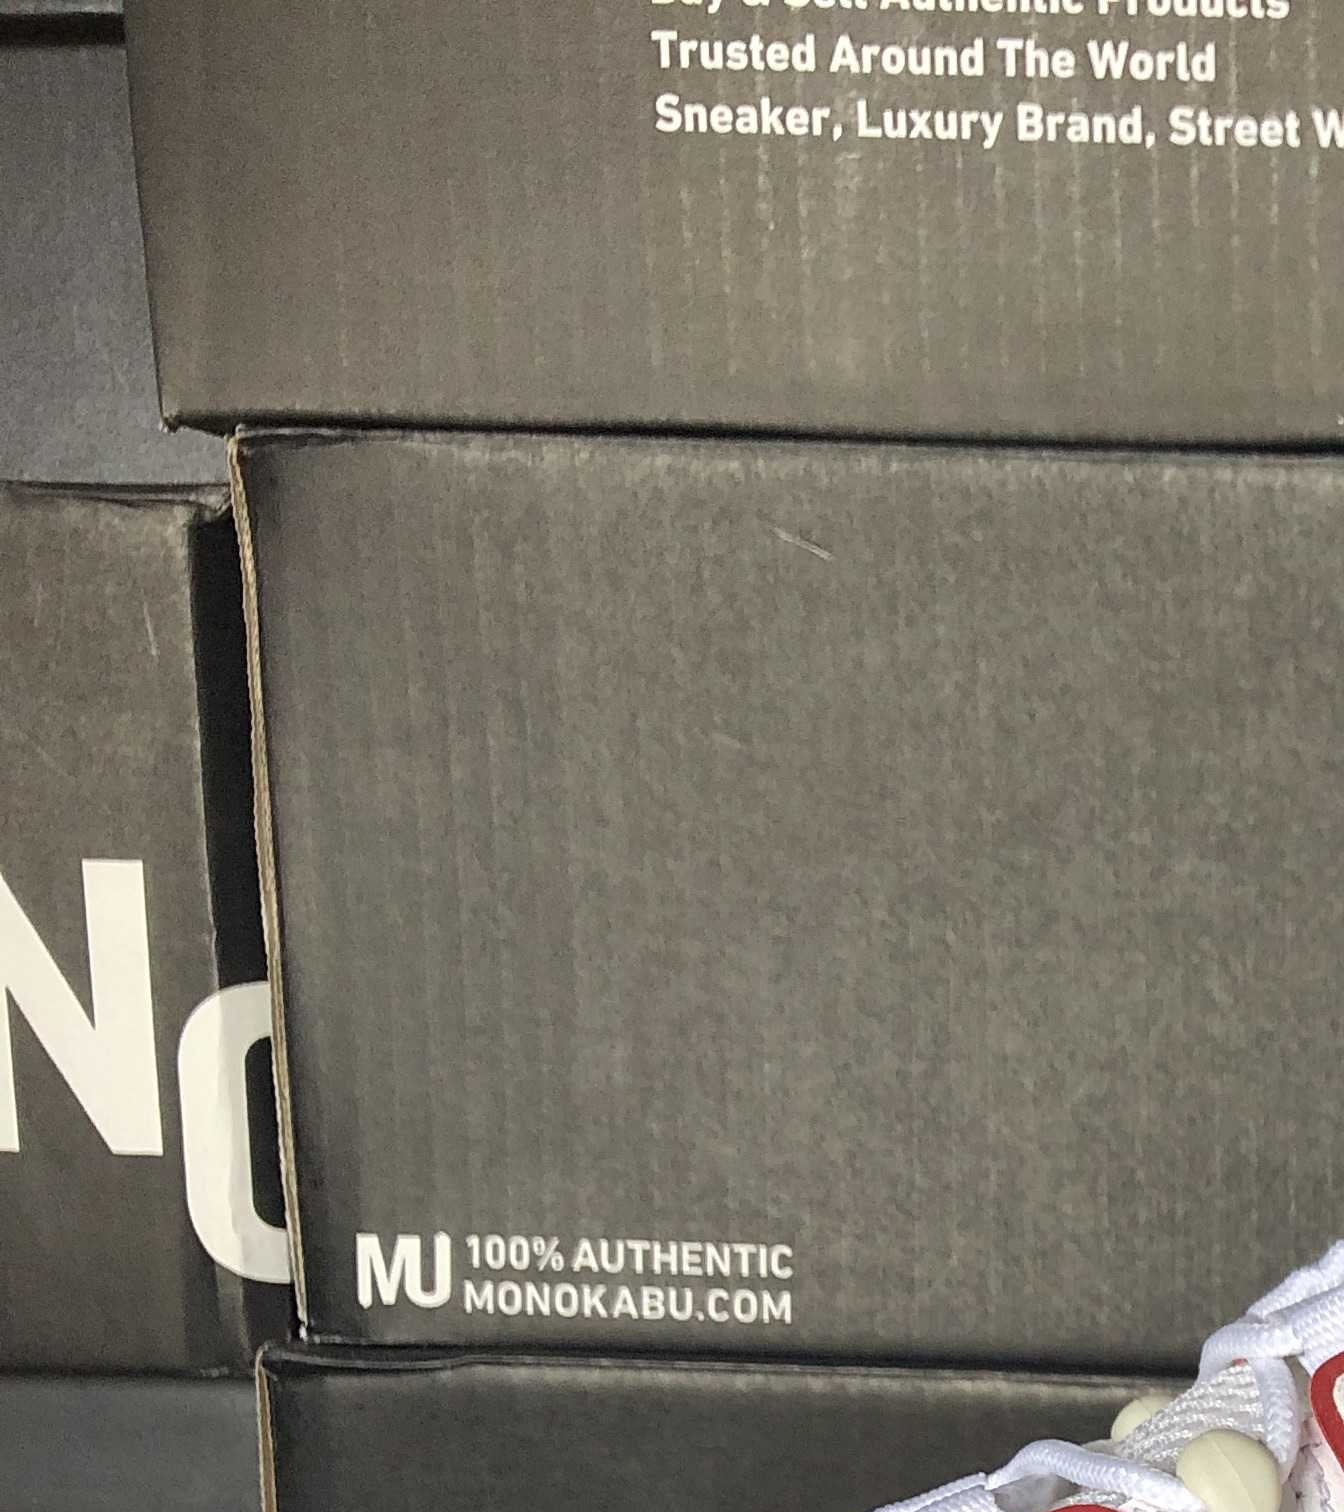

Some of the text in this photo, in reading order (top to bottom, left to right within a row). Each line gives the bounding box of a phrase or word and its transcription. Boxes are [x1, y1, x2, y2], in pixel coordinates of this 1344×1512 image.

[650, 30, 1216, 82] Trusted Around The World
[654, 93, 844, 142] Sneaker,
[855, 98, 1003, 149] Luxury
[1016, 100, 1157, 149] Brand,
[1168, 105, 1301, 148] Street
[355, 1230, 452, 1309] MU
[464, 1233, 795, 1280] 100% AUTHENTIC
[462, 1278, 793, 1325] MONOKABU.COM
